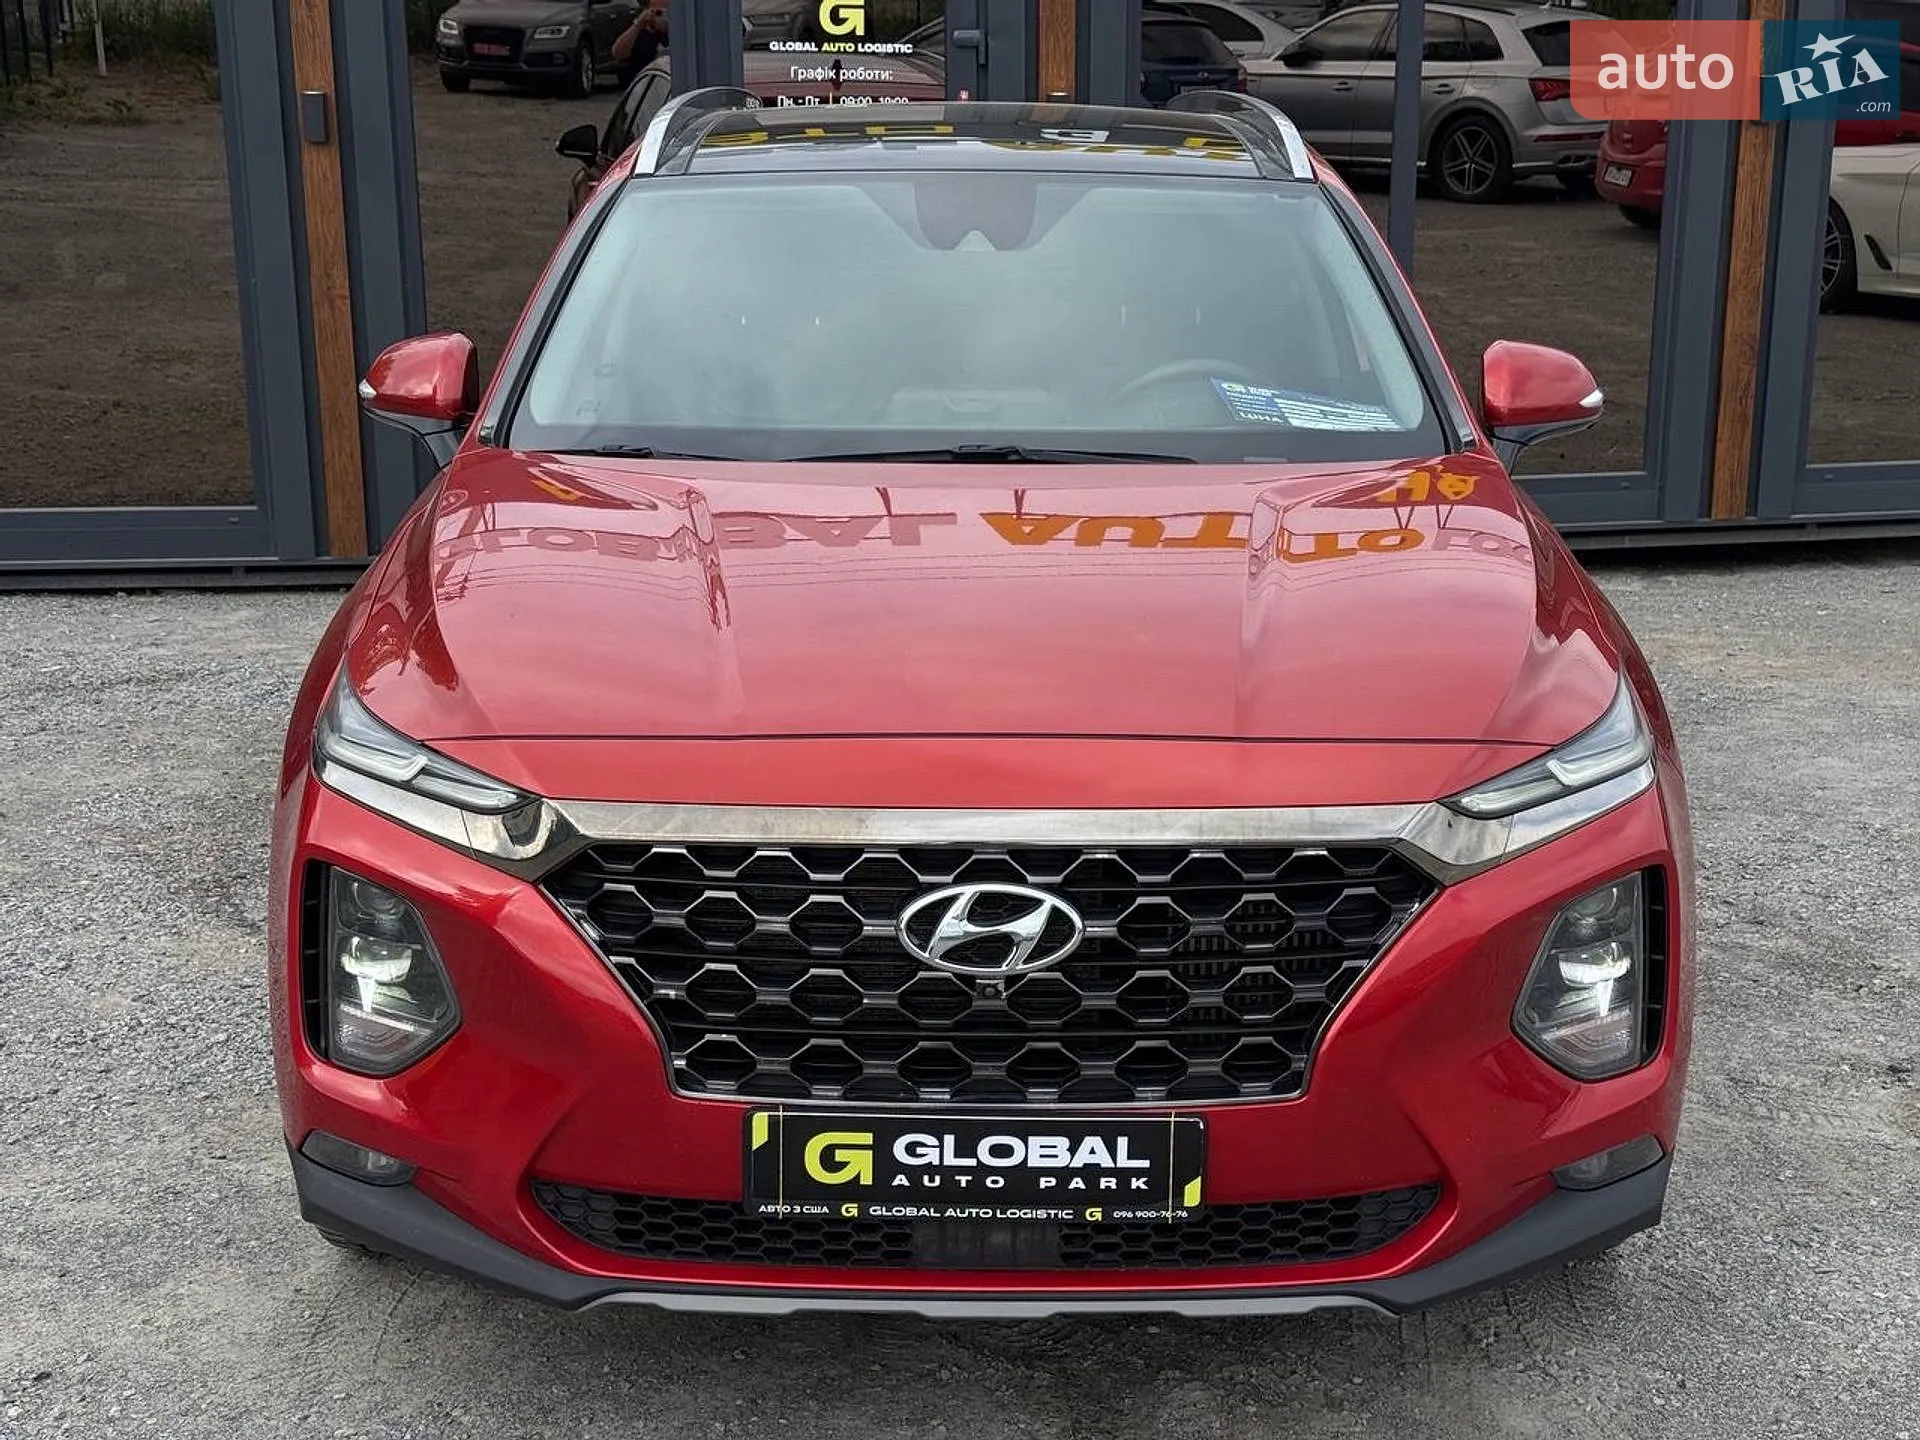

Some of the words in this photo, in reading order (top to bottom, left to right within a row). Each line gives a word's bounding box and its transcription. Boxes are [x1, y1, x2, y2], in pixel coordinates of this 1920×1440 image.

[769, 41, 818, 51] GLOBAL
[822, 43, 855, 52] AUTO
[857, 43, 913, 53] LOGISTIC
[790, 67, 837, 81] Графік
[839, 69, 893, 82] роботи:
[892, 1133, 1150, 1168] GLOBAL
[891, 1174, 1005, 1188] AUTO
[1039, 1177, 1149, 1190] PARK
[758, 1204, 791, 1214] АВТО
[803, 1205, 830, 1214] США
[869, 1206, 940, 1217] GLOBAL
[945, 1207, 993, 1218] AUTO
[996, 1208, 1074, 1219] LOGISTIC
